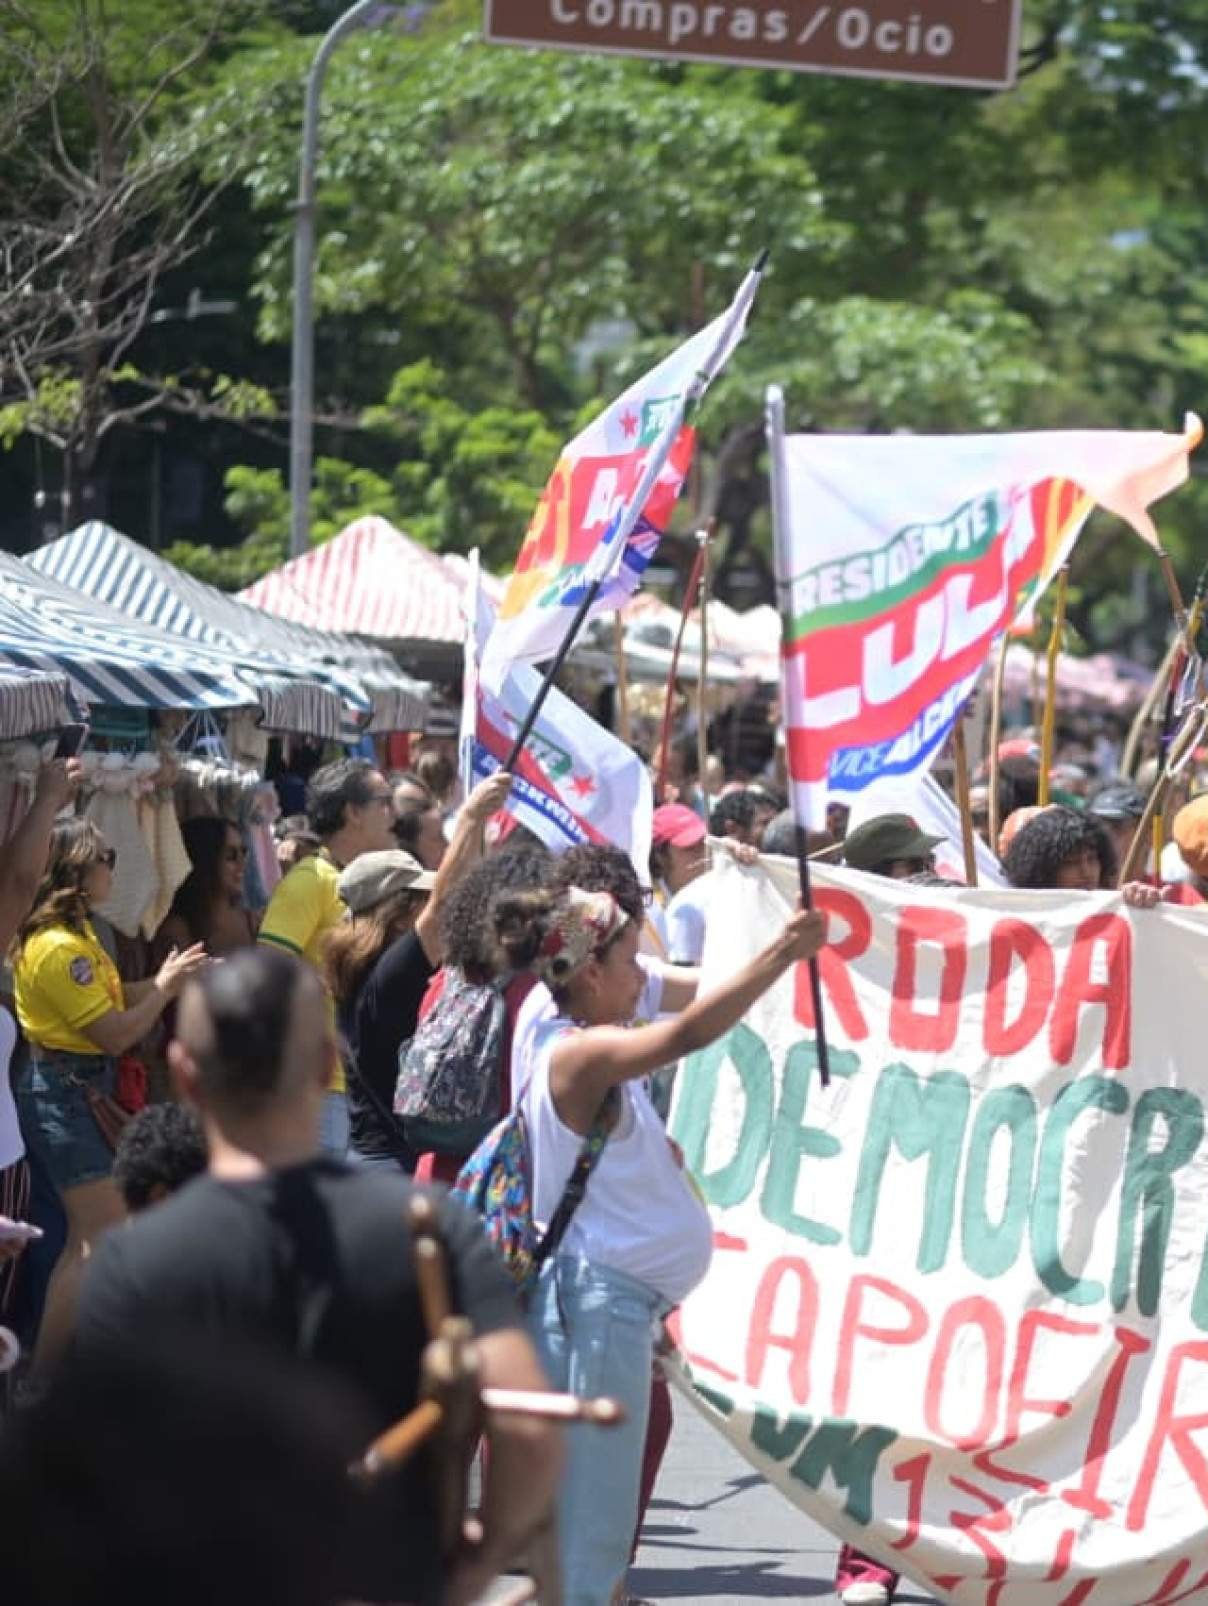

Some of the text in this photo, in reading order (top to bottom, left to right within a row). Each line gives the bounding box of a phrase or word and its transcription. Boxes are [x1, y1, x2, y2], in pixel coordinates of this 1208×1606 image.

[782, 497, 990, 619] RESIDENTE
[832, 750, 884, 777] VICE
[793, 886, 1134, 1070] RODA
